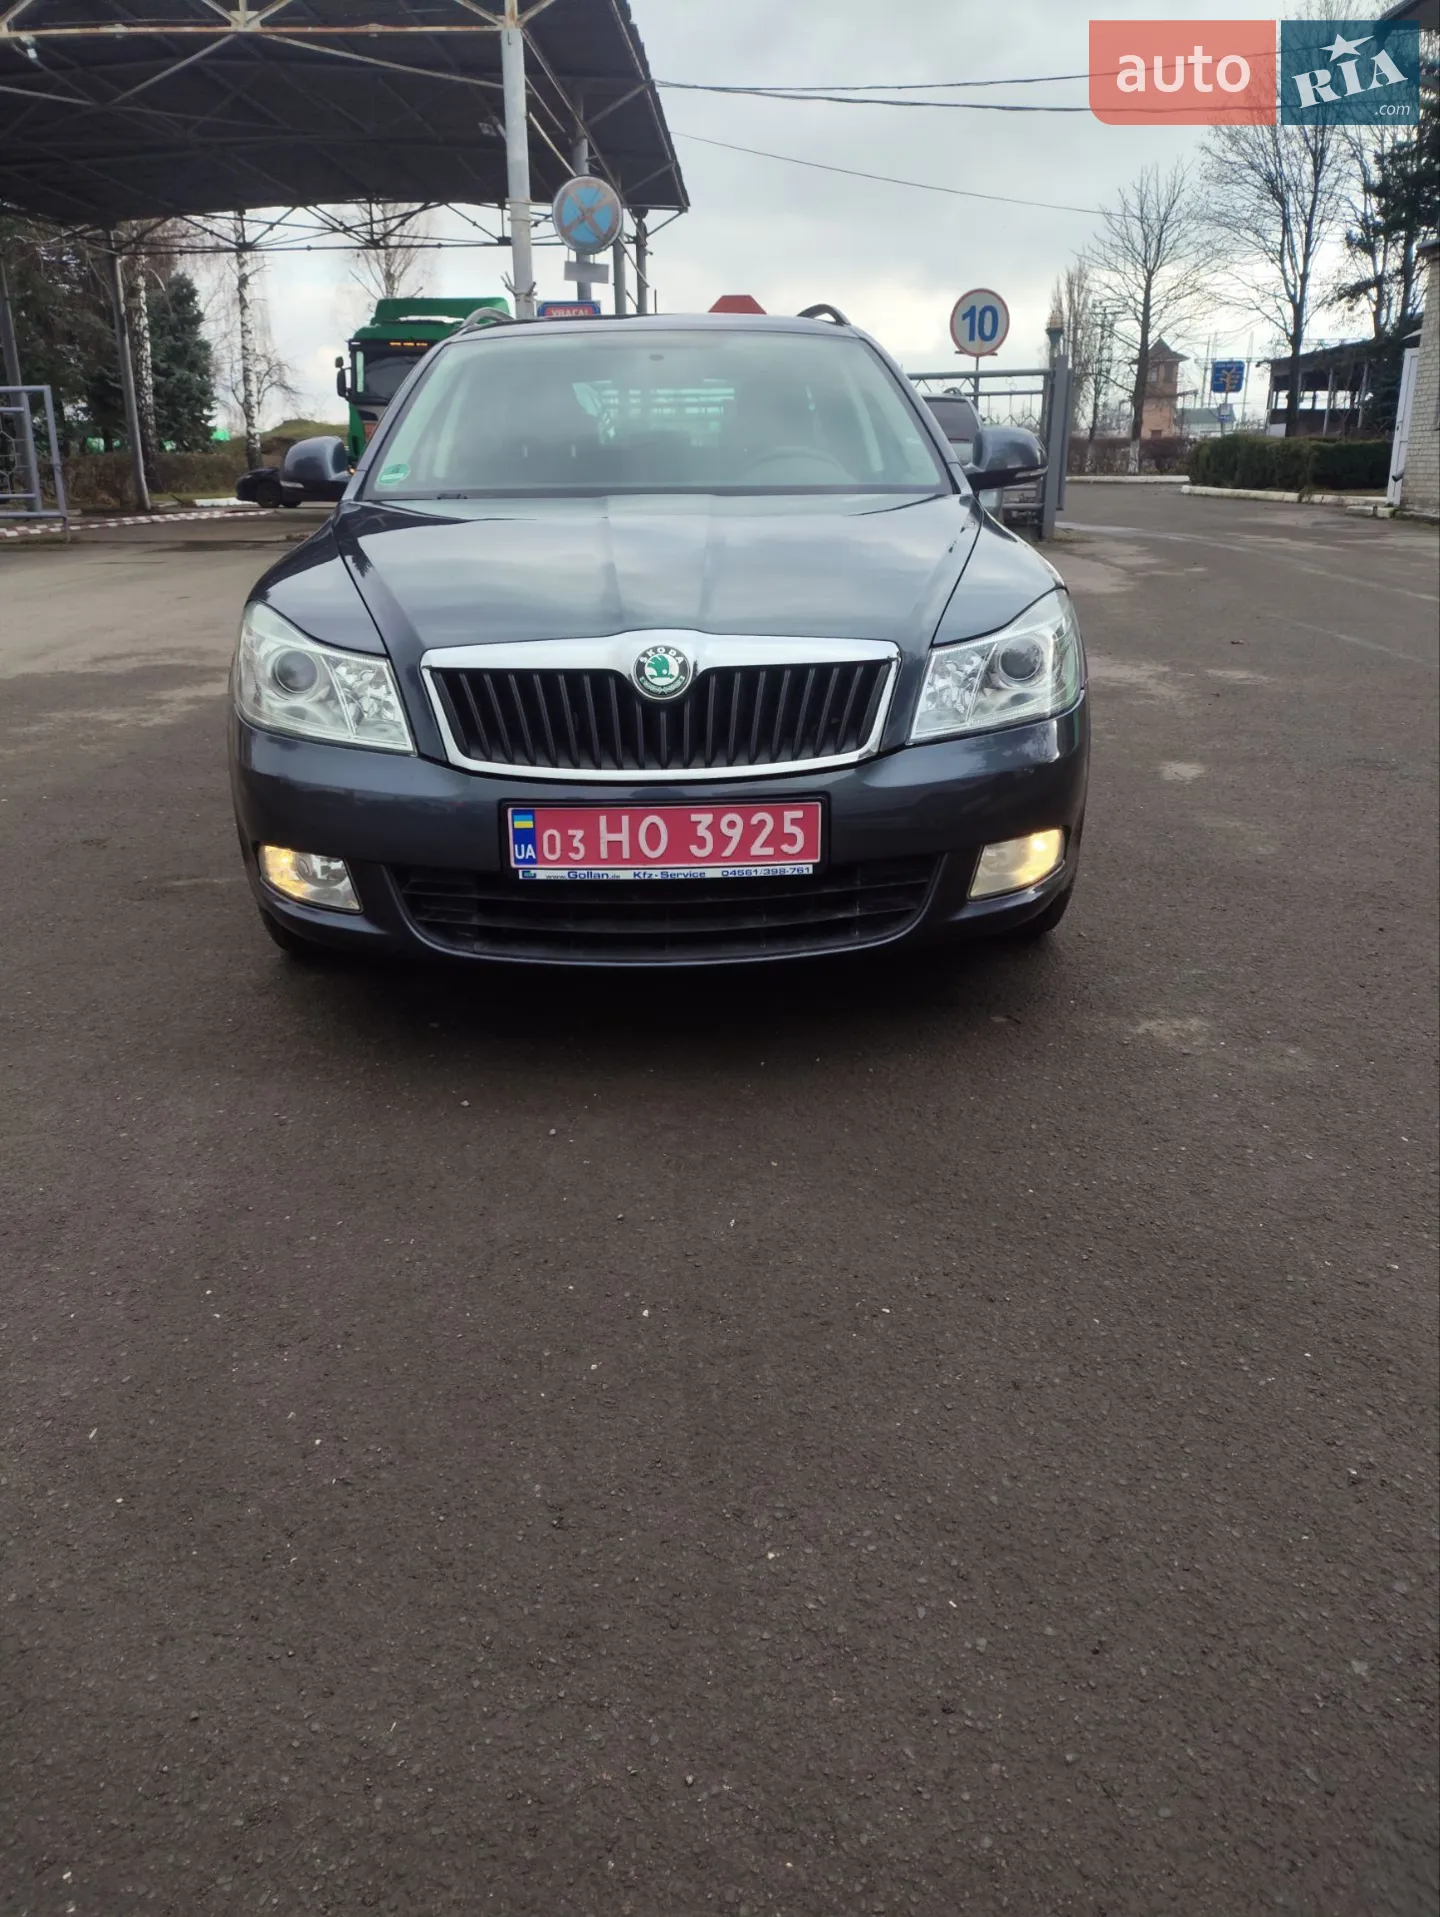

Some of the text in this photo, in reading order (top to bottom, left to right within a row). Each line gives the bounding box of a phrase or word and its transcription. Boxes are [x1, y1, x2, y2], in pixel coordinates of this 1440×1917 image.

[961, 305, 999, 342] 10
[515, 844, 536, 859] UA
[542, 828, 585, 860] 03
[689, 810, 804, 858] 3925
